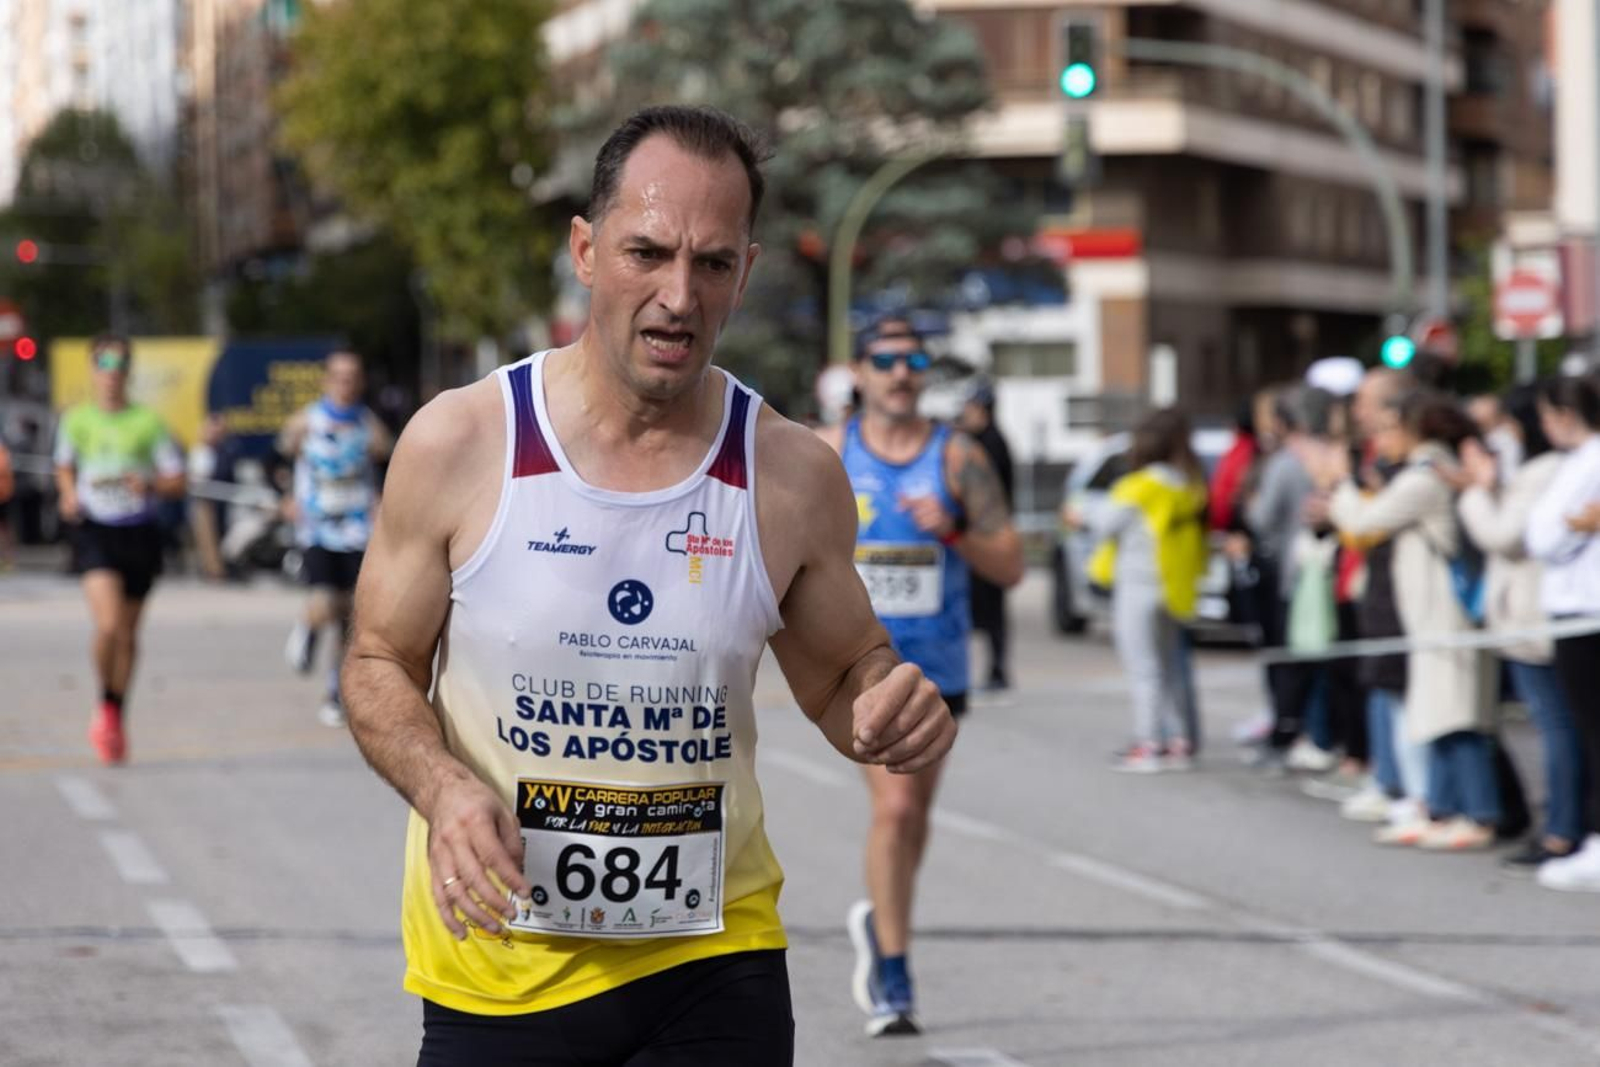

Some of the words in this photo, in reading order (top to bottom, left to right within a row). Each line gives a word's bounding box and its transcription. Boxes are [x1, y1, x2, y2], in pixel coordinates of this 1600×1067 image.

[527, 541, 597, 556] TEAMERGY
[712, 537, 721, 547] de
[559, 631, 612, 648] PABLO
[617, 635, 698, 652] CARVAJAL
[512, 673, 576, 699] CLUB
[586, 682, 620, 703] DE
[630, 685, 728, 705] RUNNING
[516, 695, 631, 730] SANTA
[692, 706, 727, 730] DE
[497, 716, 552, 758] LOS
[524, 783, 573, 813] XXV
[575, 788, 650, 805] CARRERA
[653, 787, 716, 804] POPULAR
[574, 801, 585, 816] y
[594, 803, 638, 818] gran
[544, 815, 568, 829] POR
[569, 817, 588, 831] LA
[587, 820, 611, 834] PAZ
[621, 821, 640, 835] LA
[556, 843, 683, 903] 684
